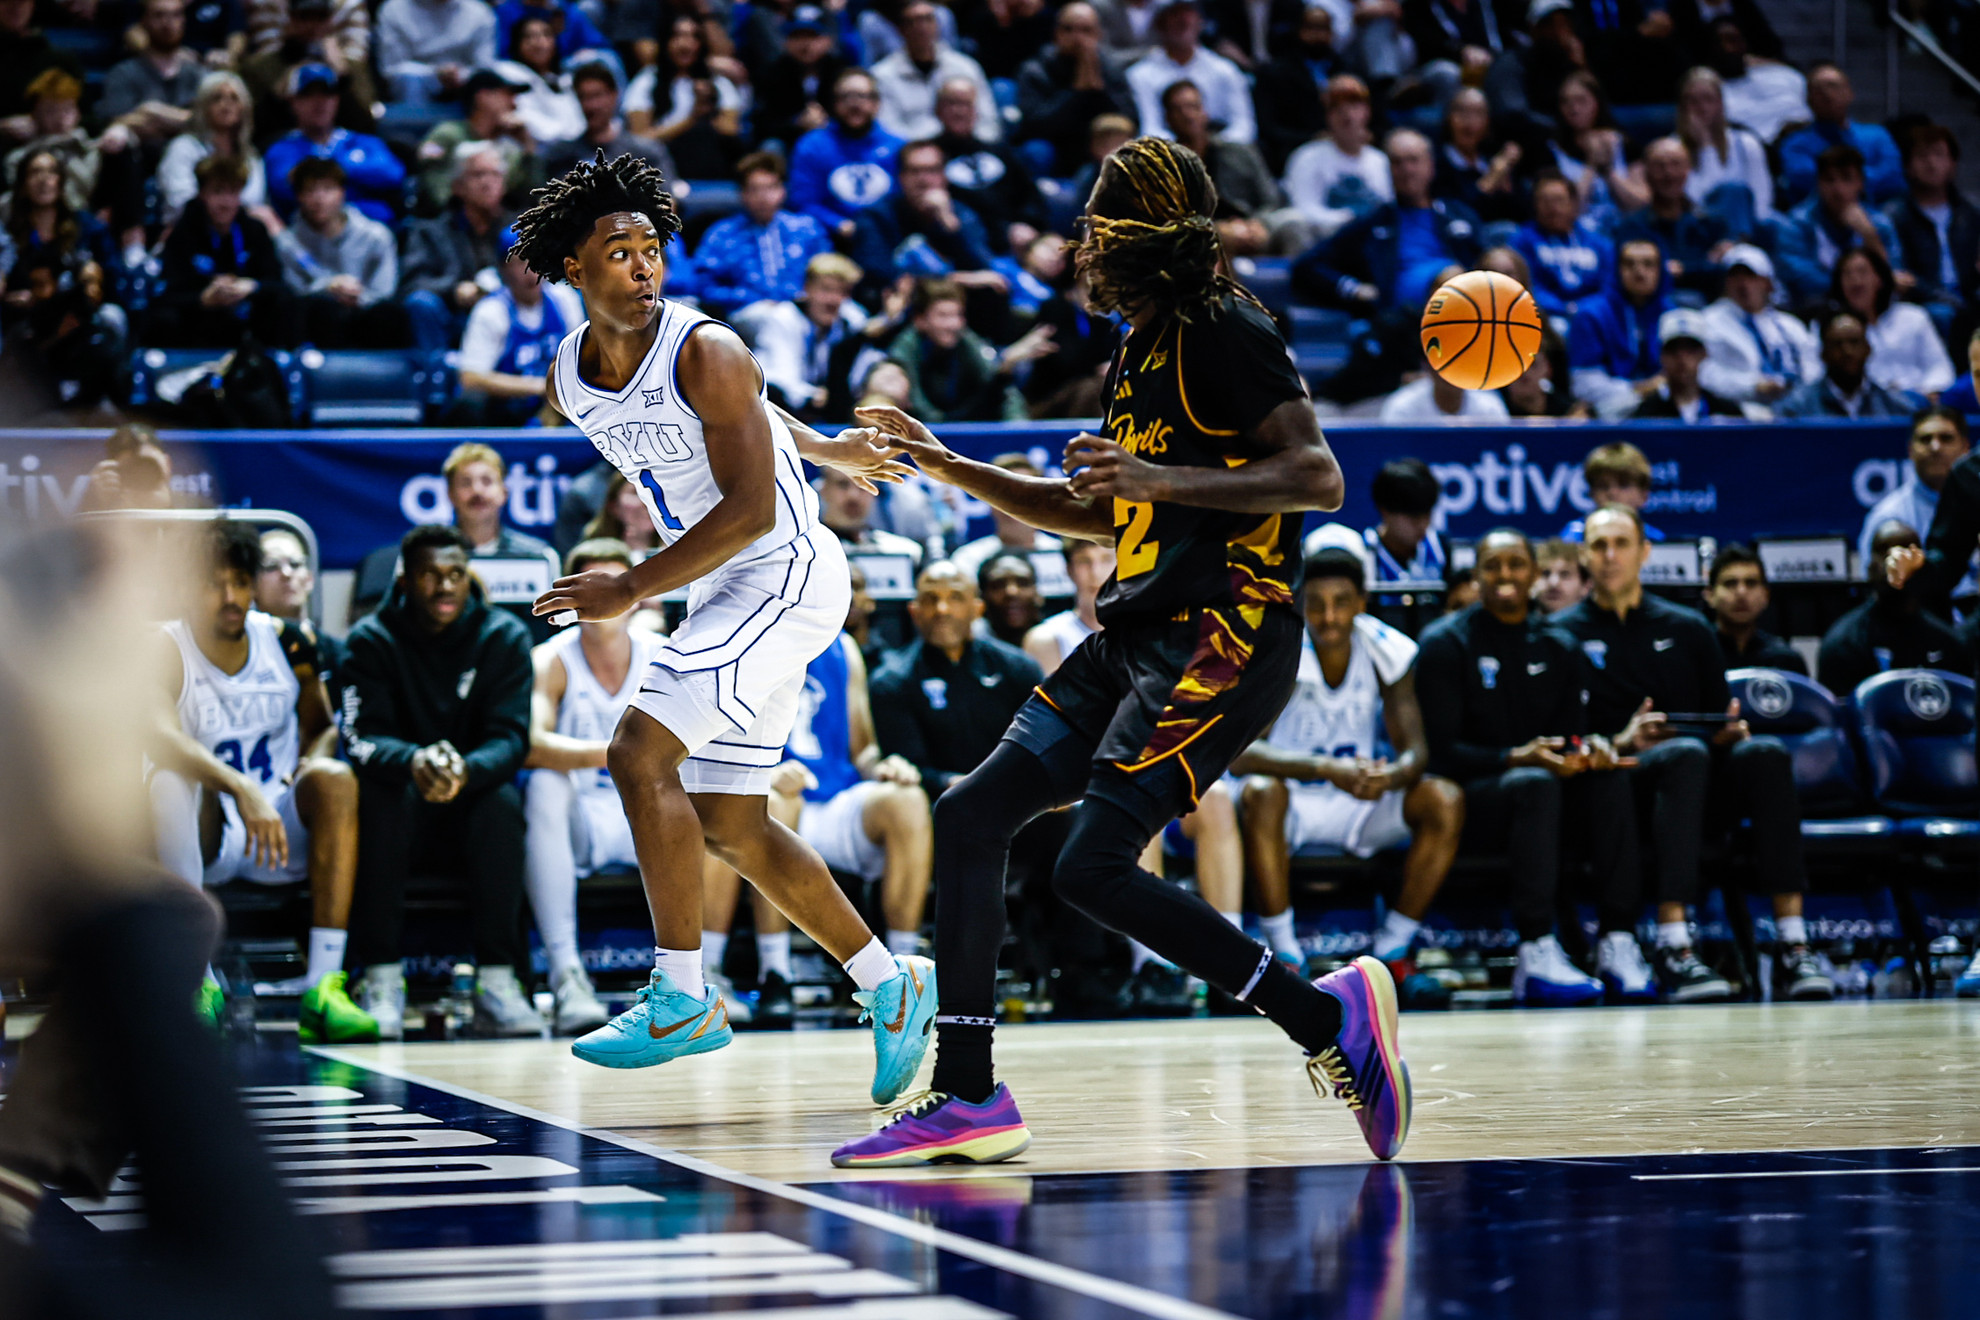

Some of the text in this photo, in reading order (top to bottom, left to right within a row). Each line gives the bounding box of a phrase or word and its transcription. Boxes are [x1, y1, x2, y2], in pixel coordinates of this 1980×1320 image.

[589, 422, 693, 468] BYU
[170, 471, 213, 496] est
[400, 454, 573, 526] ati
[639, 469, 686, 530] 1
[1428, 443, 1597, 532] ptive
[1113, 497, 1159, 581] 2
[199, 693, 285, 735] BYU
